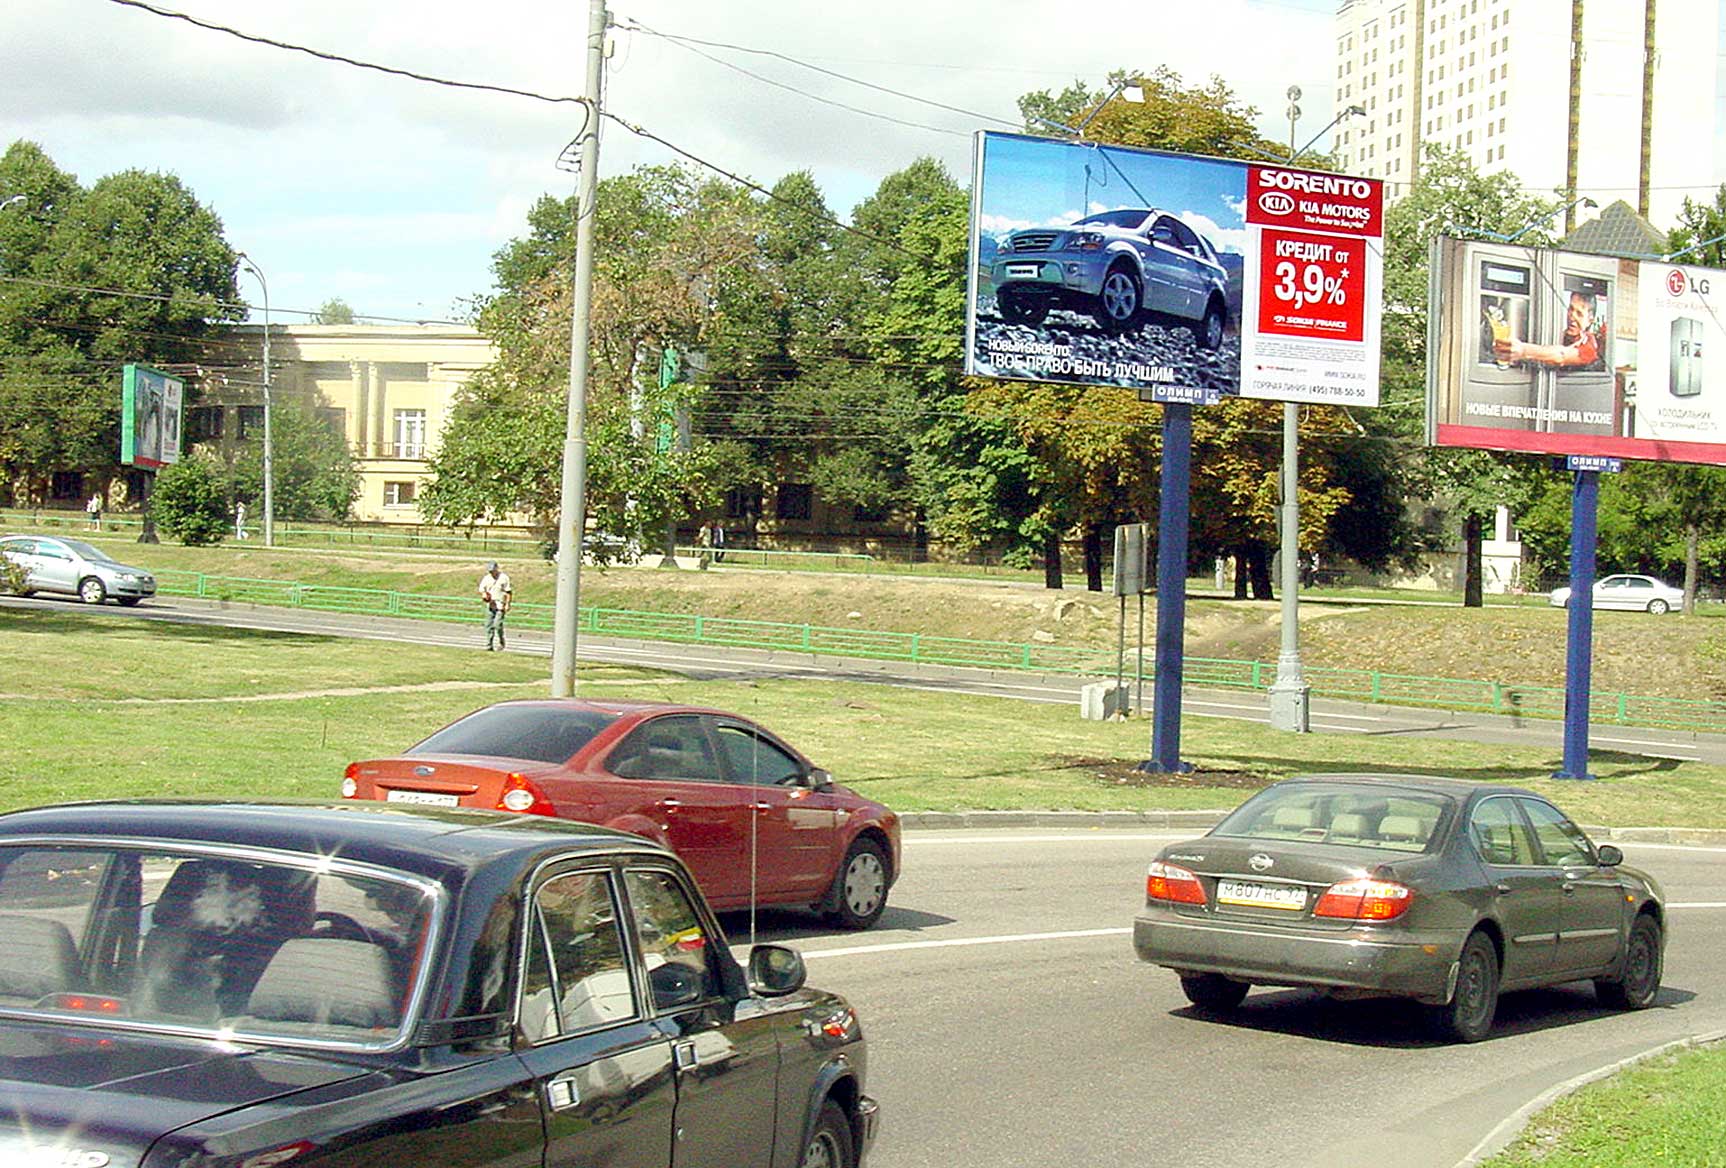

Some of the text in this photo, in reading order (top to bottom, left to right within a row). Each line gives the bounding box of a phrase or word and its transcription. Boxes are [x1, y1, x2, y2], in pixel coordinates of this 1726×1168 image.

[1259, 169, 1371, 199] SORENTO
[1265, 196, 1289, 210] KIA
[1299, 200, 1371, 220] KIA MOTORS
[1275, 239, 1333, 262] КРЕДИТ
[1690, 277, 1710, 295] LG
[988, 339, 1023, 353] НОВЫЙ
[1026, 355, 1071, 374] ПРАВО
[1074, 359, 1112, 378] БЫТЬ
[1114, 361, 1174, 382] ЛУЧШИМ
[1157, 386, 1202, 399] ОЛИМП
[1465, 402, 1613, 425] НОВЫЕ ВПЕЧАТЛЕНИЯ НА КУХНЕ
[1571, 456, 1606, 467] ОЛИМП
